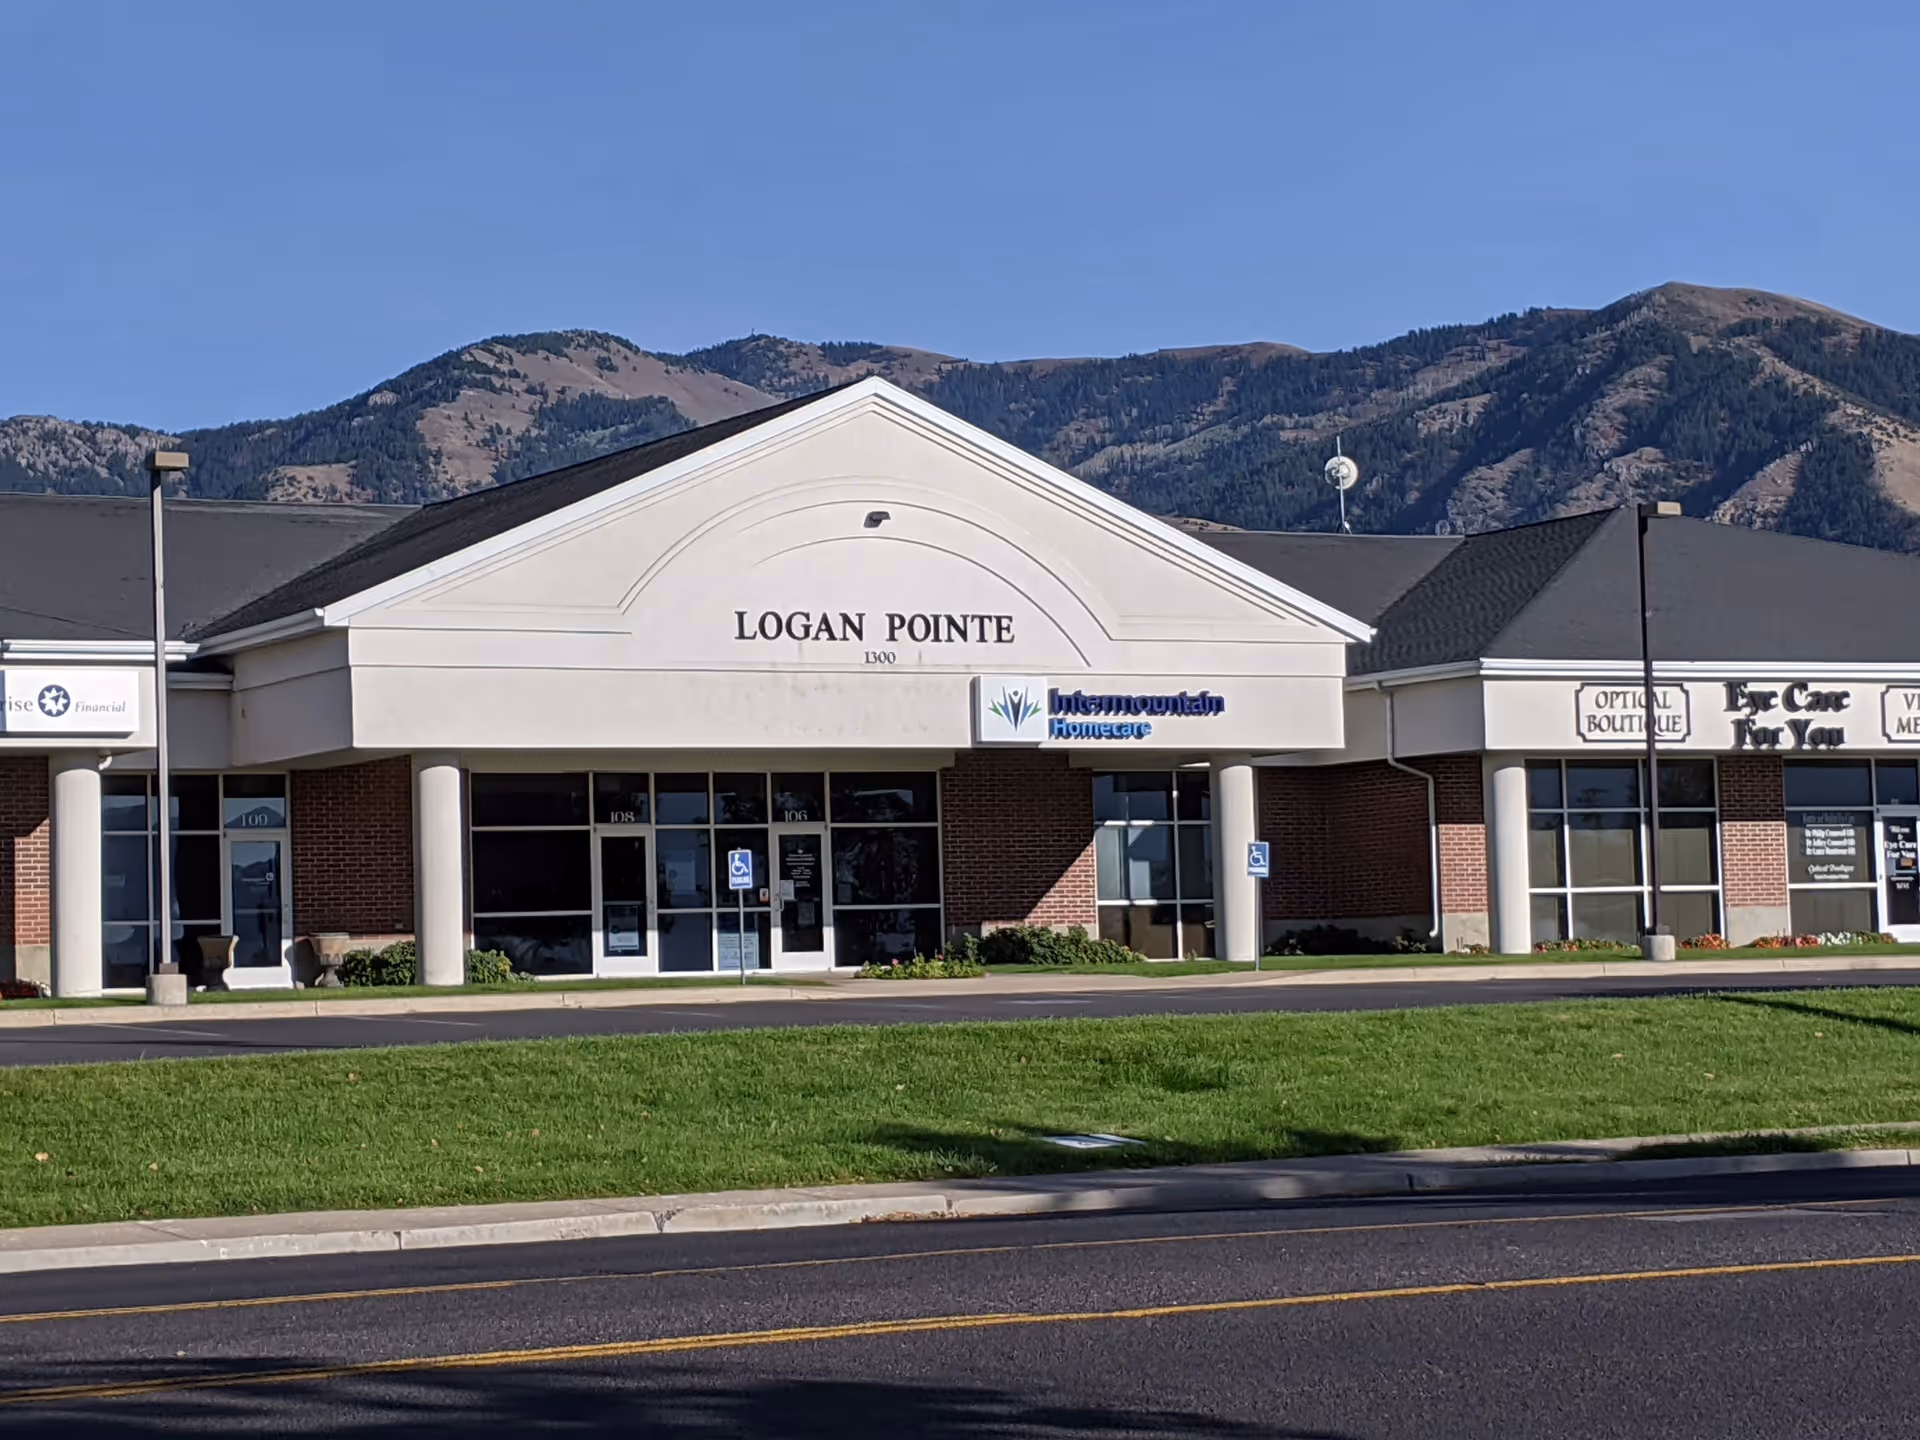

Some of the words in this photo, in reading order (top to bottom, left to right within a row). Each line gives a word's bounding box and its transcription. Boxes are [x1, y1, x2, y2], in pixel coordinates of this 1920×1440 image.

[734, 610, 866, 642] LOGAN
[885, 612, 1016, 644] POINTE
[864, 650, 896, 665] 1300
[74, 700, 127, 713] Financial
[1047, 687, 1226, 717] Intermountain
[1594, 690, 1672, 710] OPTICAL
[1723, 681, 1779, 717] Eye
[1782, 681, 1851, 713] Care
[1047, 717, 1153, 740] Homecare
[1730, 717, 1785, 750] For
[1785, 717, 1847, 750] You
[1896, 715, 1920, 735] ME
[611, 811, 635, 823] 108
[784, 810, 808, 823] 106
